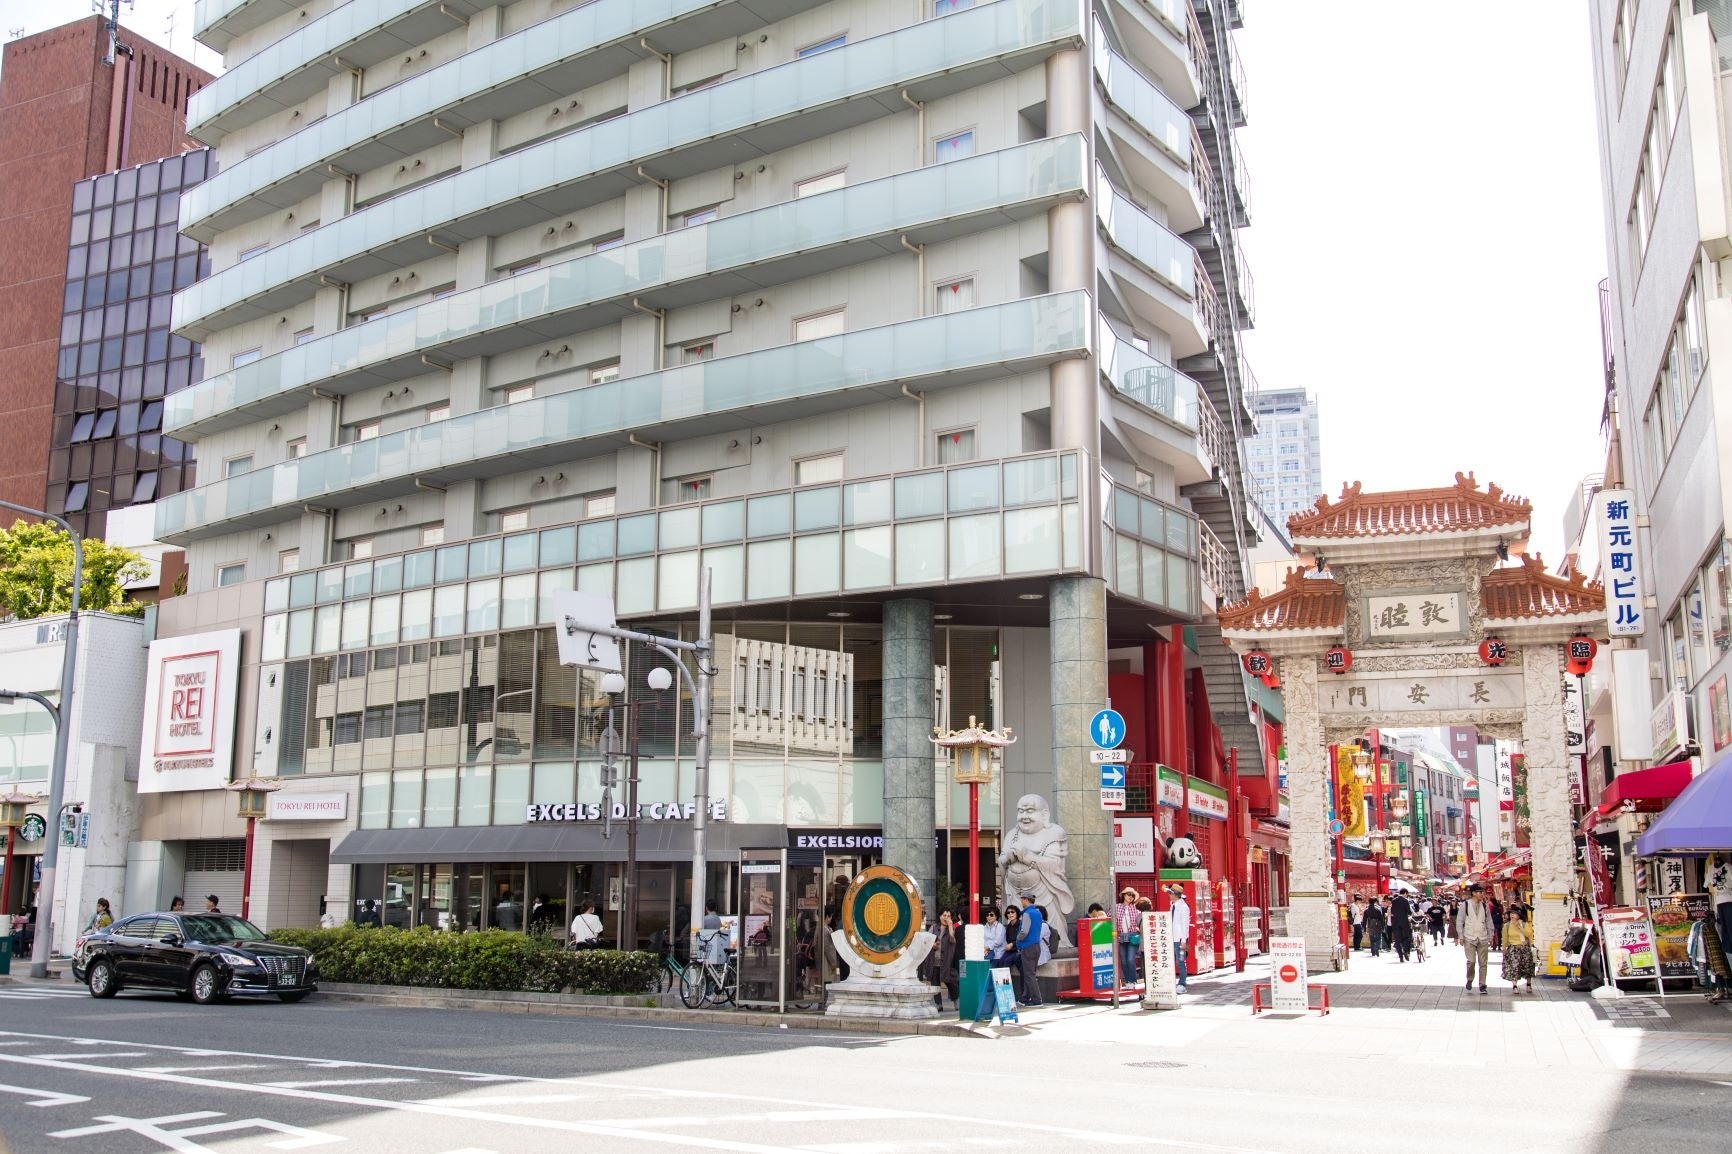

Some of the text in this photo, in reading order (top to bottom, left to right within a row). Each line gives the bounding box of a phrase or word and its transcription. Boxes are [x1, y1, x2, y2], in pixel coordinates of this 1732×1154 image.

[1607, 500, 1640, 624] 新元町ビル
[1488, 642, 1506, 659] 光
[174, 672, 207, 687] TOKYU
[171, 687, 203, 720] REI
[169, 722, 203, 738] HOTEL
[276, 802, 341, 810] TOKYU REI HOTEL
[526, 798, 726, 822] EXCELSOR CAFÉ
[797, 836, 883, 848] EXCELSIOR
